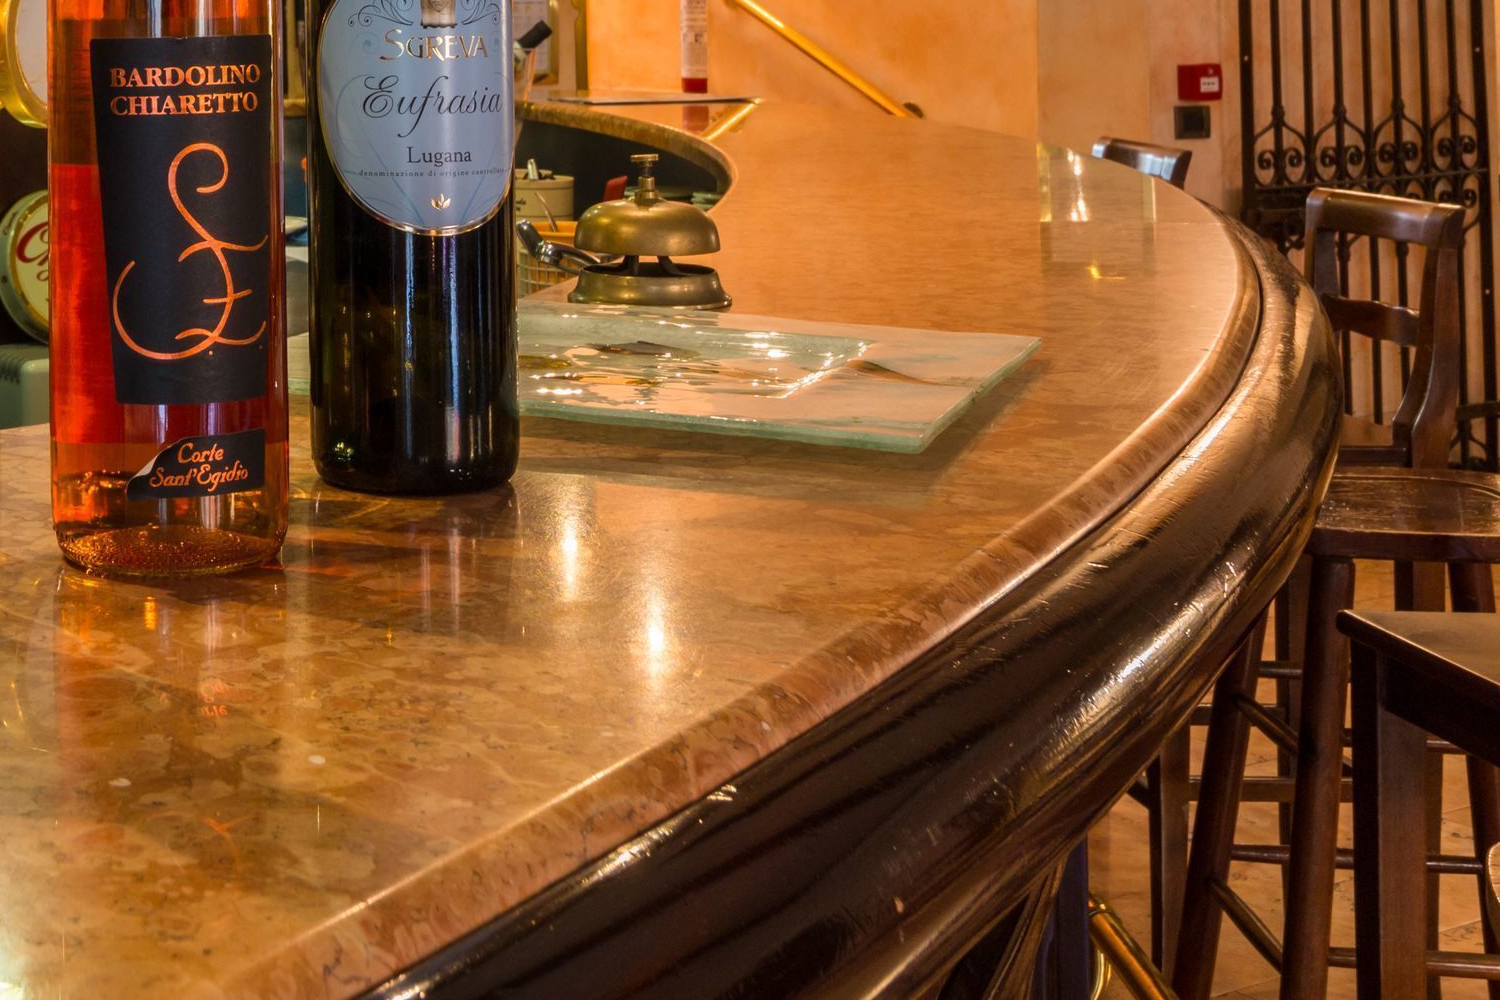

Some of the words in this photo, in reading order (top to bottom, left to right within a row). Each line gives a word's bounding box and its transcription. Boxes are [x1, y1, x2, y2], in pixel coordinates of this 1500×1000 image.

[380, 28, 490, 62] SGREVA
[110, 63, 261, 88] BARDOLINO
[110, 91, 259, 116] CHIARETTO
[362, 75, 503, 138] Eufrasia
[407, 146, 472, 168] Lugana
[427, 169, 437, 177] di
[177, 442, 225, 464] Corte
[149, 460, 249, 493] Sant'Egidio
